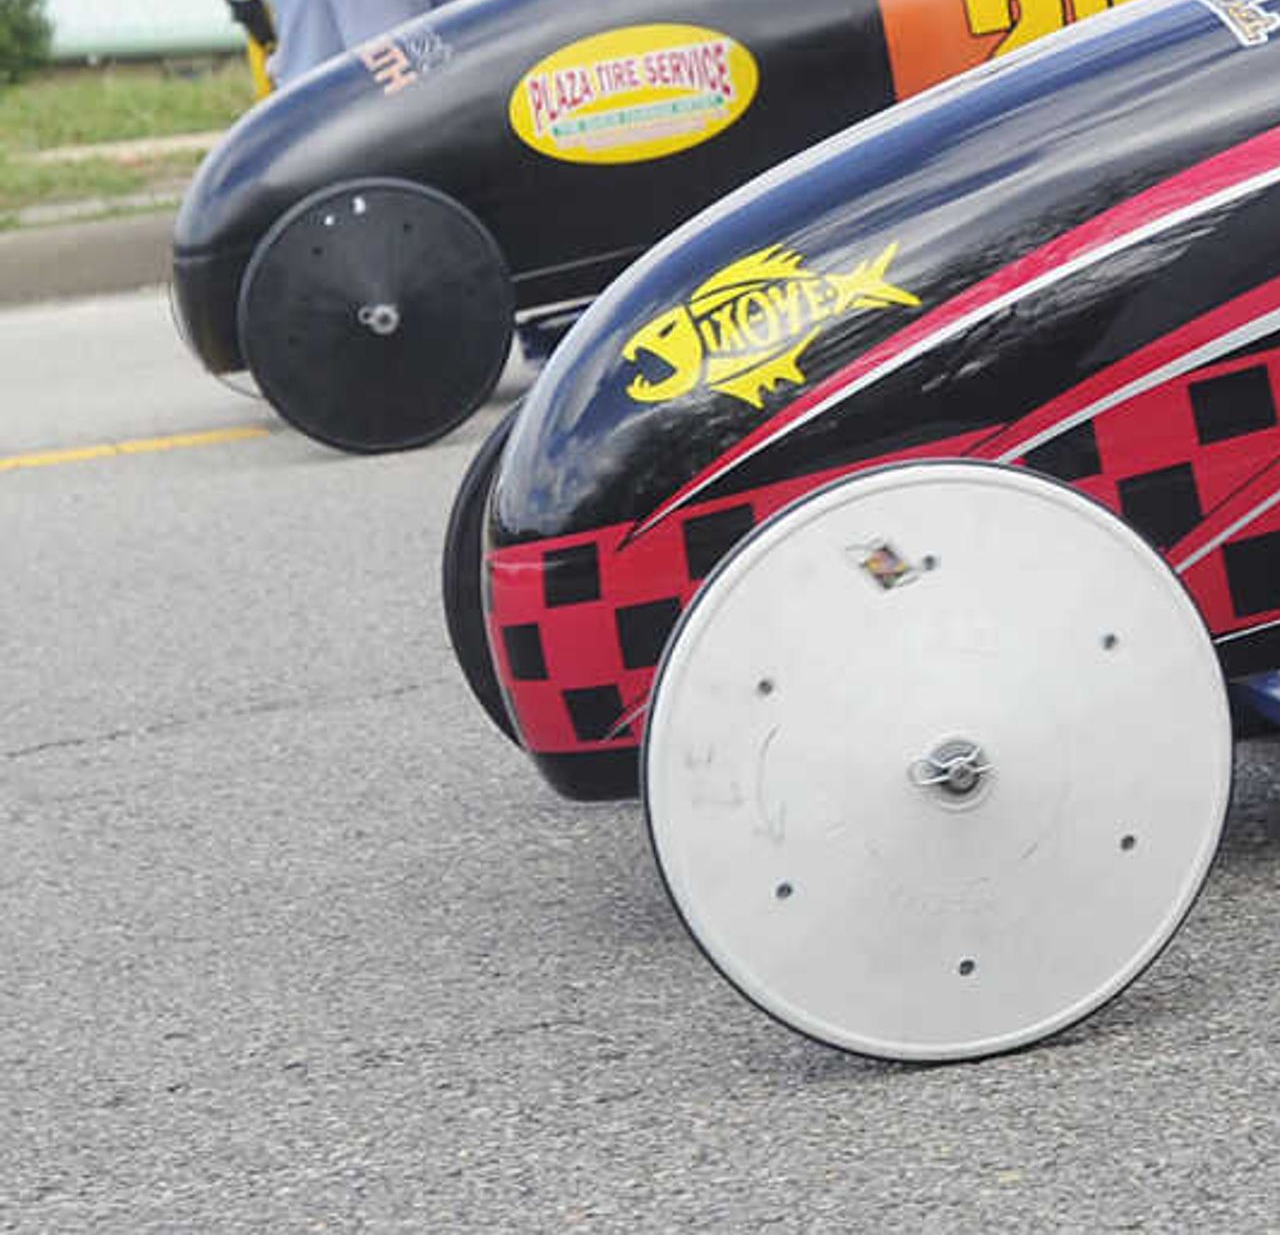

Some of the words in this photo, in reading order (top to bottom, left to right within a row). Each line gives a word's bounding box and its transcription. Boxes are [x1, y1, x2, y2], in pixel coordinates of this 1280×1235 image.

[529, 70, 595, 133] PLAZA
[596, 59, 640, 94] TIRE
[643, 42, 733, 96] SERVICE
